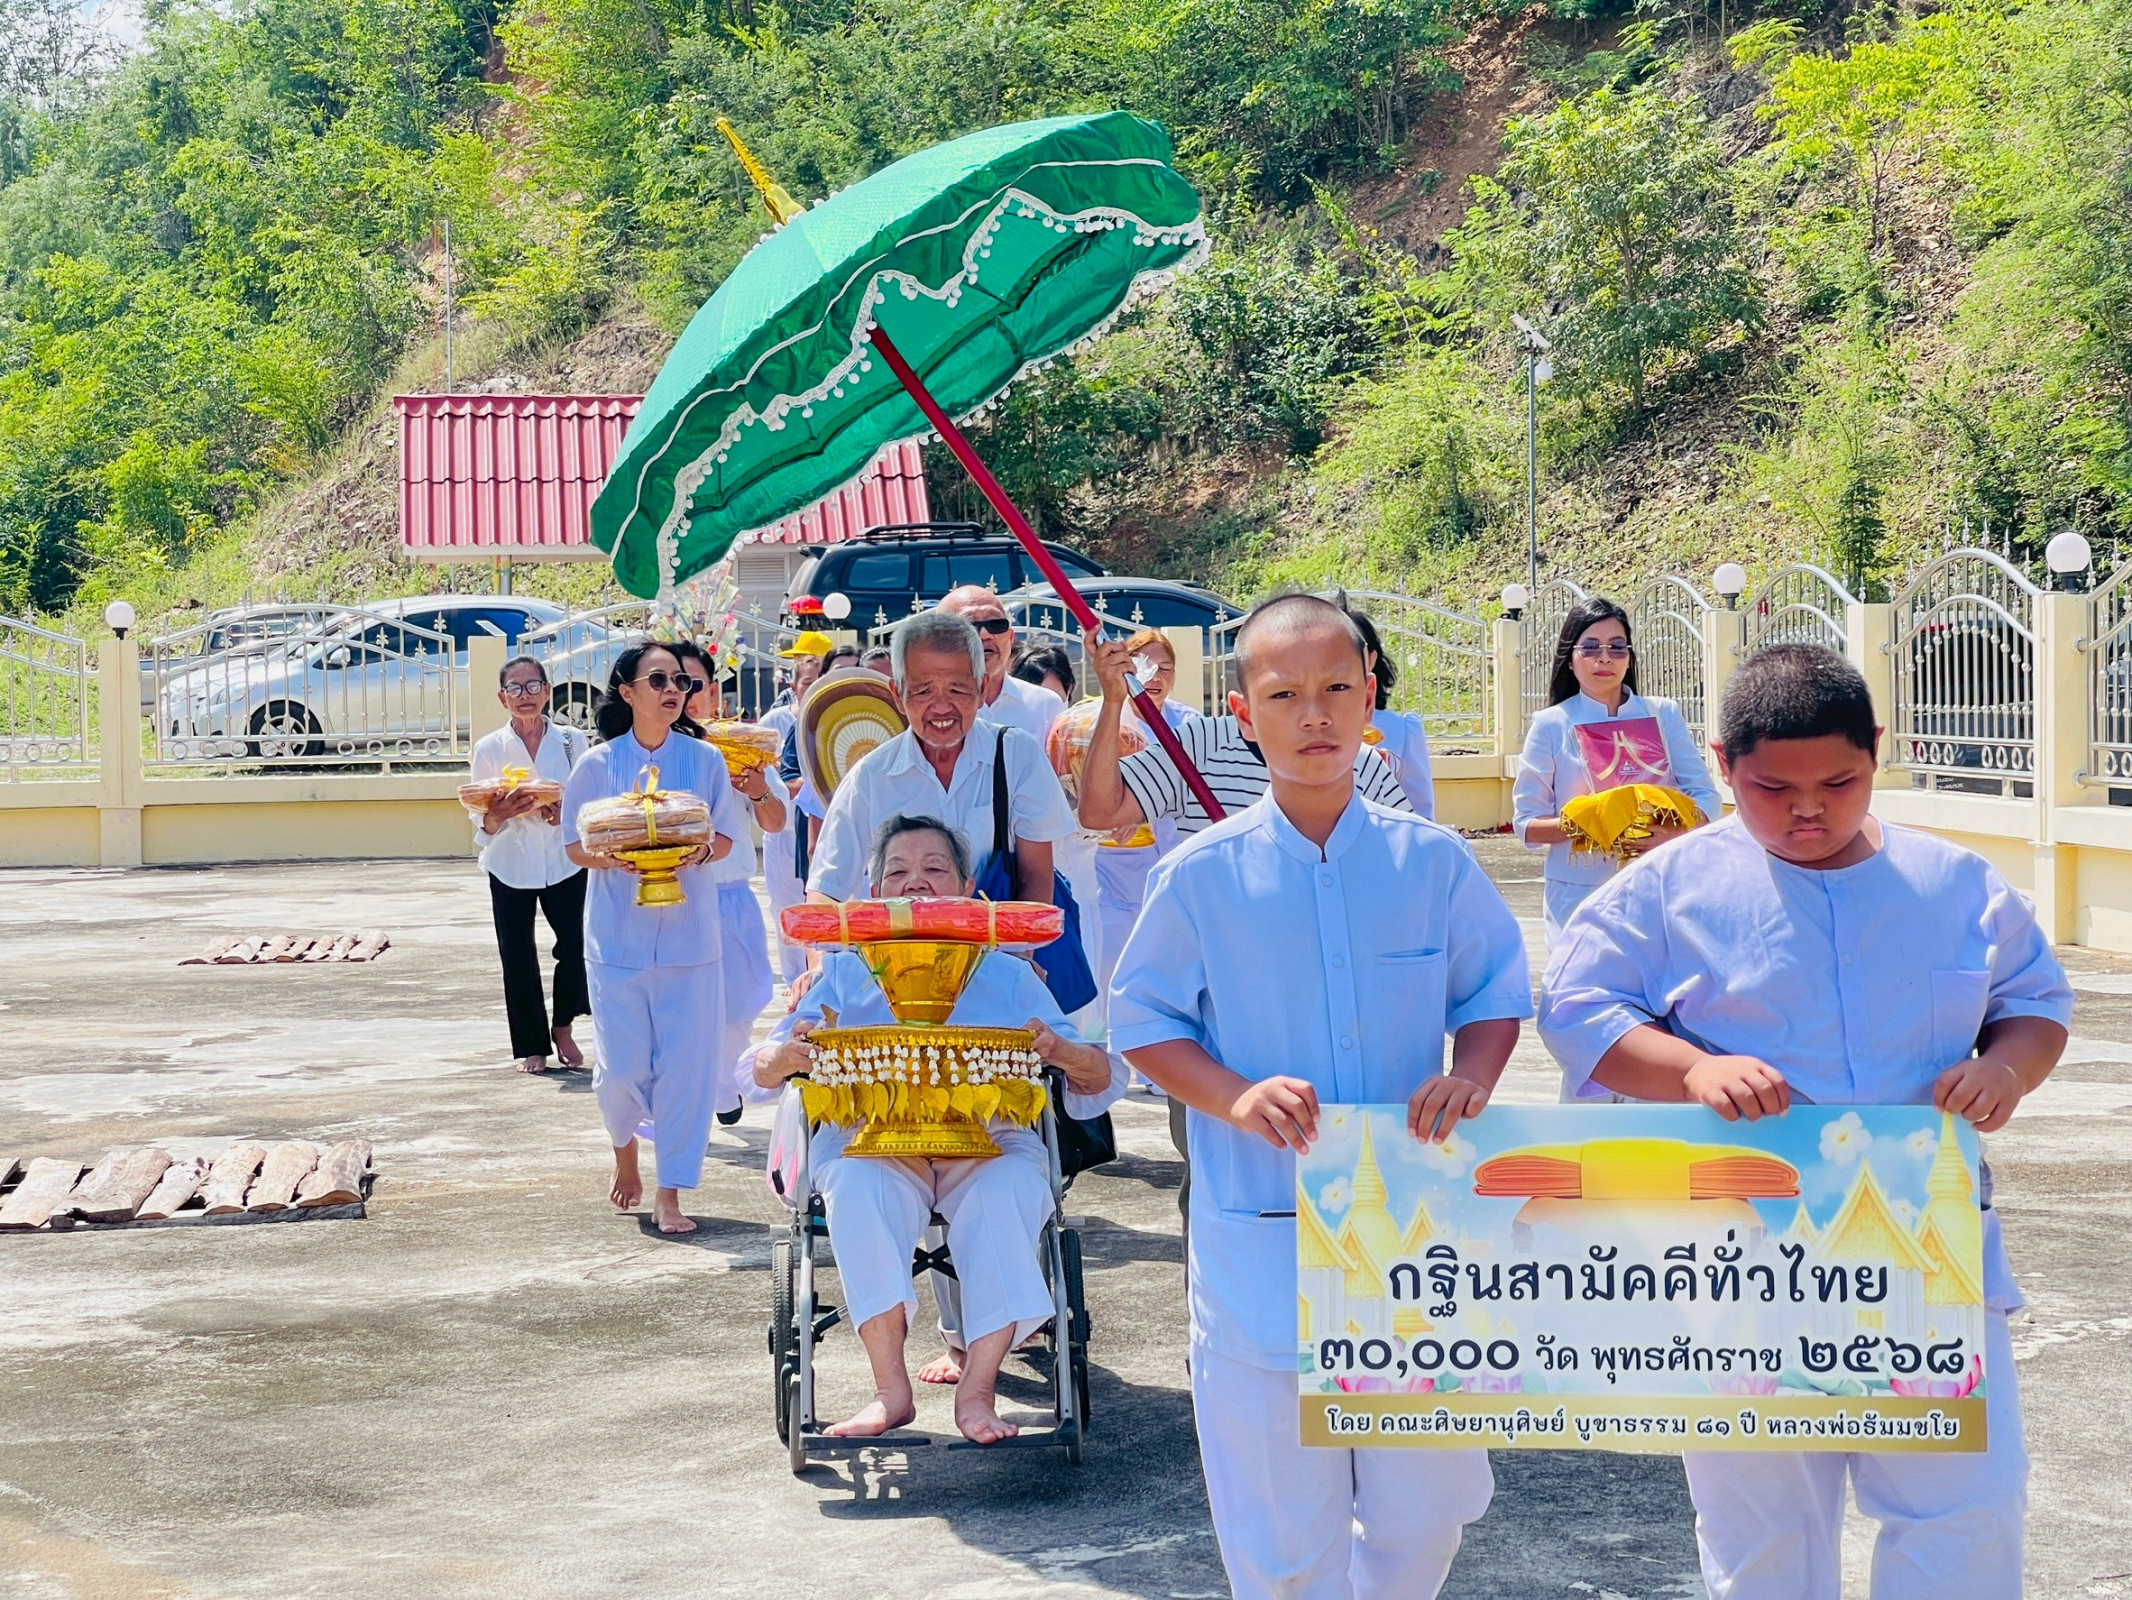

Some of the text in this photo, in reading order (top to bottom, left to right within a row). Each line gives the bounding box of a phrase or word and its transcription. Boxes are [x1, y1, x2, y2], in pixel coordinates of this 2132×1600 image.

[1388, 1228, 1888, 1318] กฐินสามัคคีทั่วไทย
[1320, 1334, 1965, 1384] ๓๐,๐๐๐ วัด พุทธศักราช ๒๕๖๘
[1327, 1408, 1958, 1441] โดย คณะศิษยานุศิษย์ บูชาธรรม ๘๑ ปี หลวงพ่อธัมมชโย
